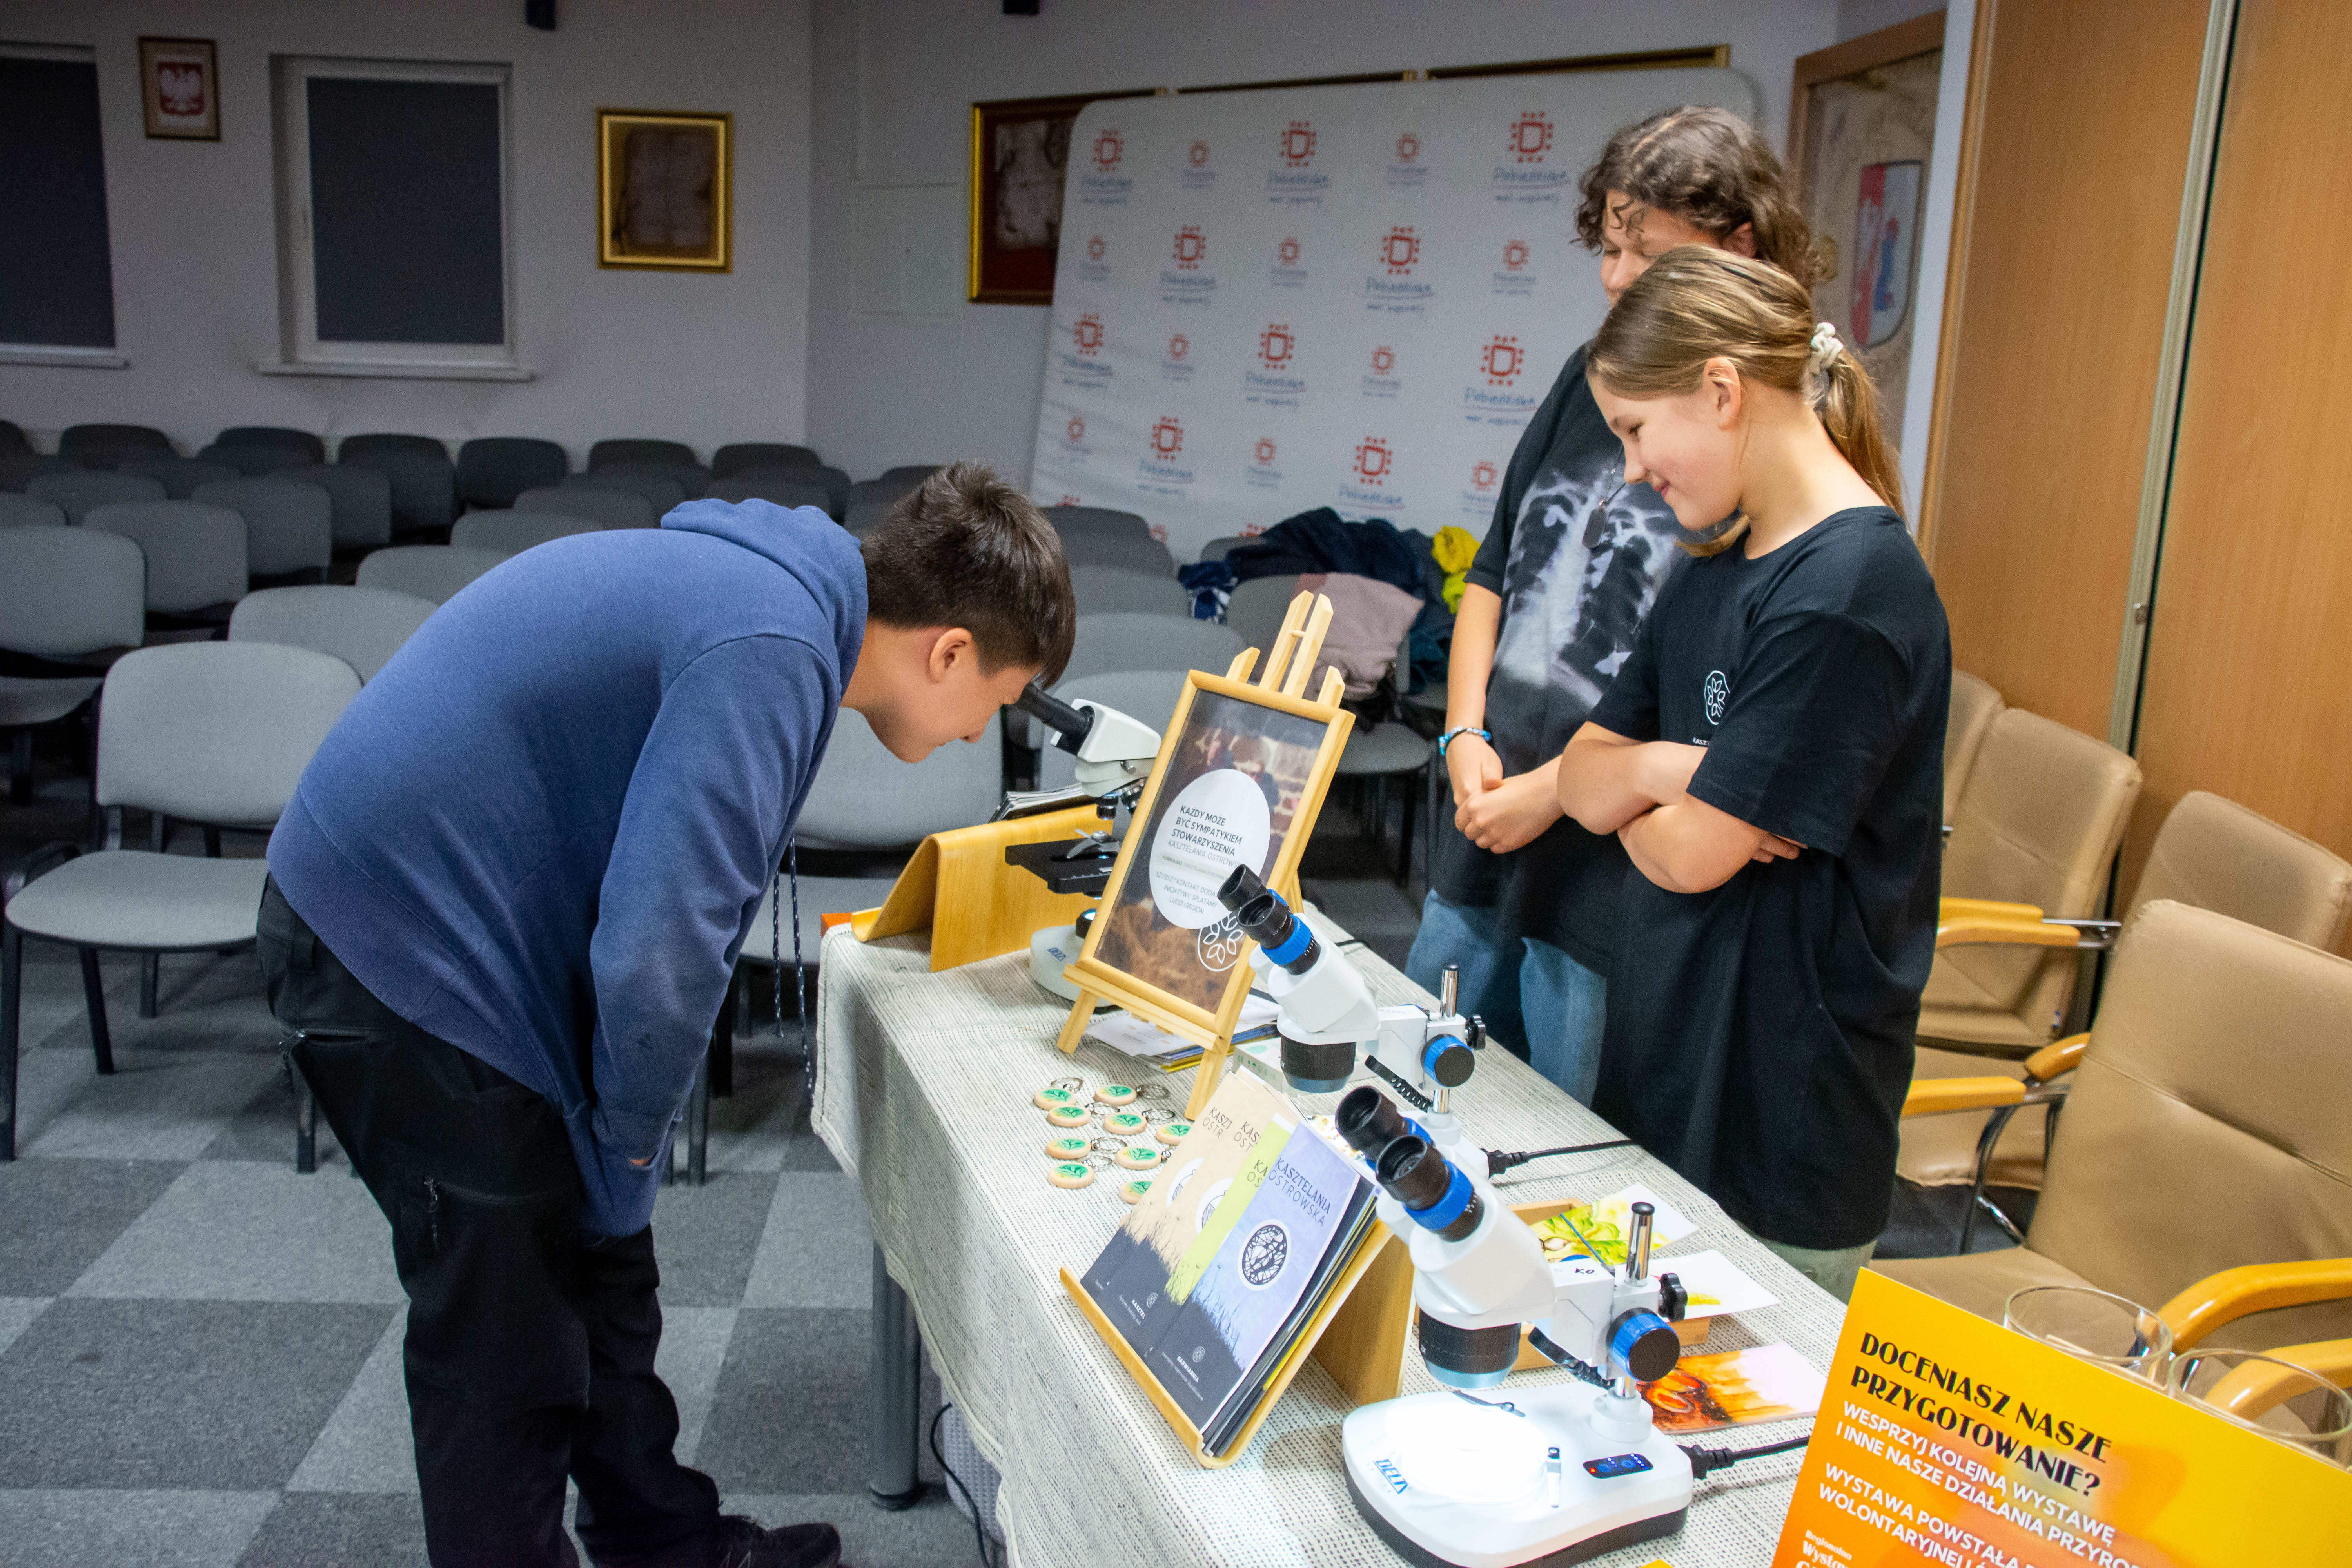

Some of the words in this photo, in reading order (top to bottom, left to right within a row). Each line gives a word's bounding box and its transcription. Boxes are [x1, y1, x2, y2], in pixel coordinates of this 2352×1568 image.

[1171, 829, 1235, 856] STOWARZYSZENIA
[1175, 817, 1191, 828] BYĆ
[1191, 822, 1243, 845] SYMPATYKIEM
[1205, 813, 1226, 826] MOŻE
[1168, 839, 1206, 858] KASZTELANIA
[1269, 1169, 1325, 1227] OSTROWSKA
[1275, 1157, 1331, 1214] KASZTELANIA
[1131, 1299, 1146, 1319] KASZTEL
[1176, 1356, 1199, 1383] BARWIARNIA
[1860, 1332, 2011, 1417] DOCENIASZ
[2015, 1401, 2112, 1463] NASZE
[1850, 1365, 2101, 1496] PRZYGOTOWANIE?
[1836, 1421, 1843, 1436] I
[1844, 1425, 1885, 1457] INNE
[1886, 1445, 1944, 1486] NASZE
[1944, 1474, 2043, 1537] DZIAŁANIA
[2047, 1525, 2140, 1568] PRZYRO
[1844, 1400, 1928, 1455] WESPRZYJ
[1929, 1442, 2007, 1496] KOLEJNĄ
[2013, 1481, 2116, 1547] WYSTAWĘ
[1819, 1483, 1964, 1568] WOLONTARYJNEJ
[1825, 1462, 1913, 1521] WYSTAWA
[1917, 1510, 2019, 1568] POWSTAŁA
